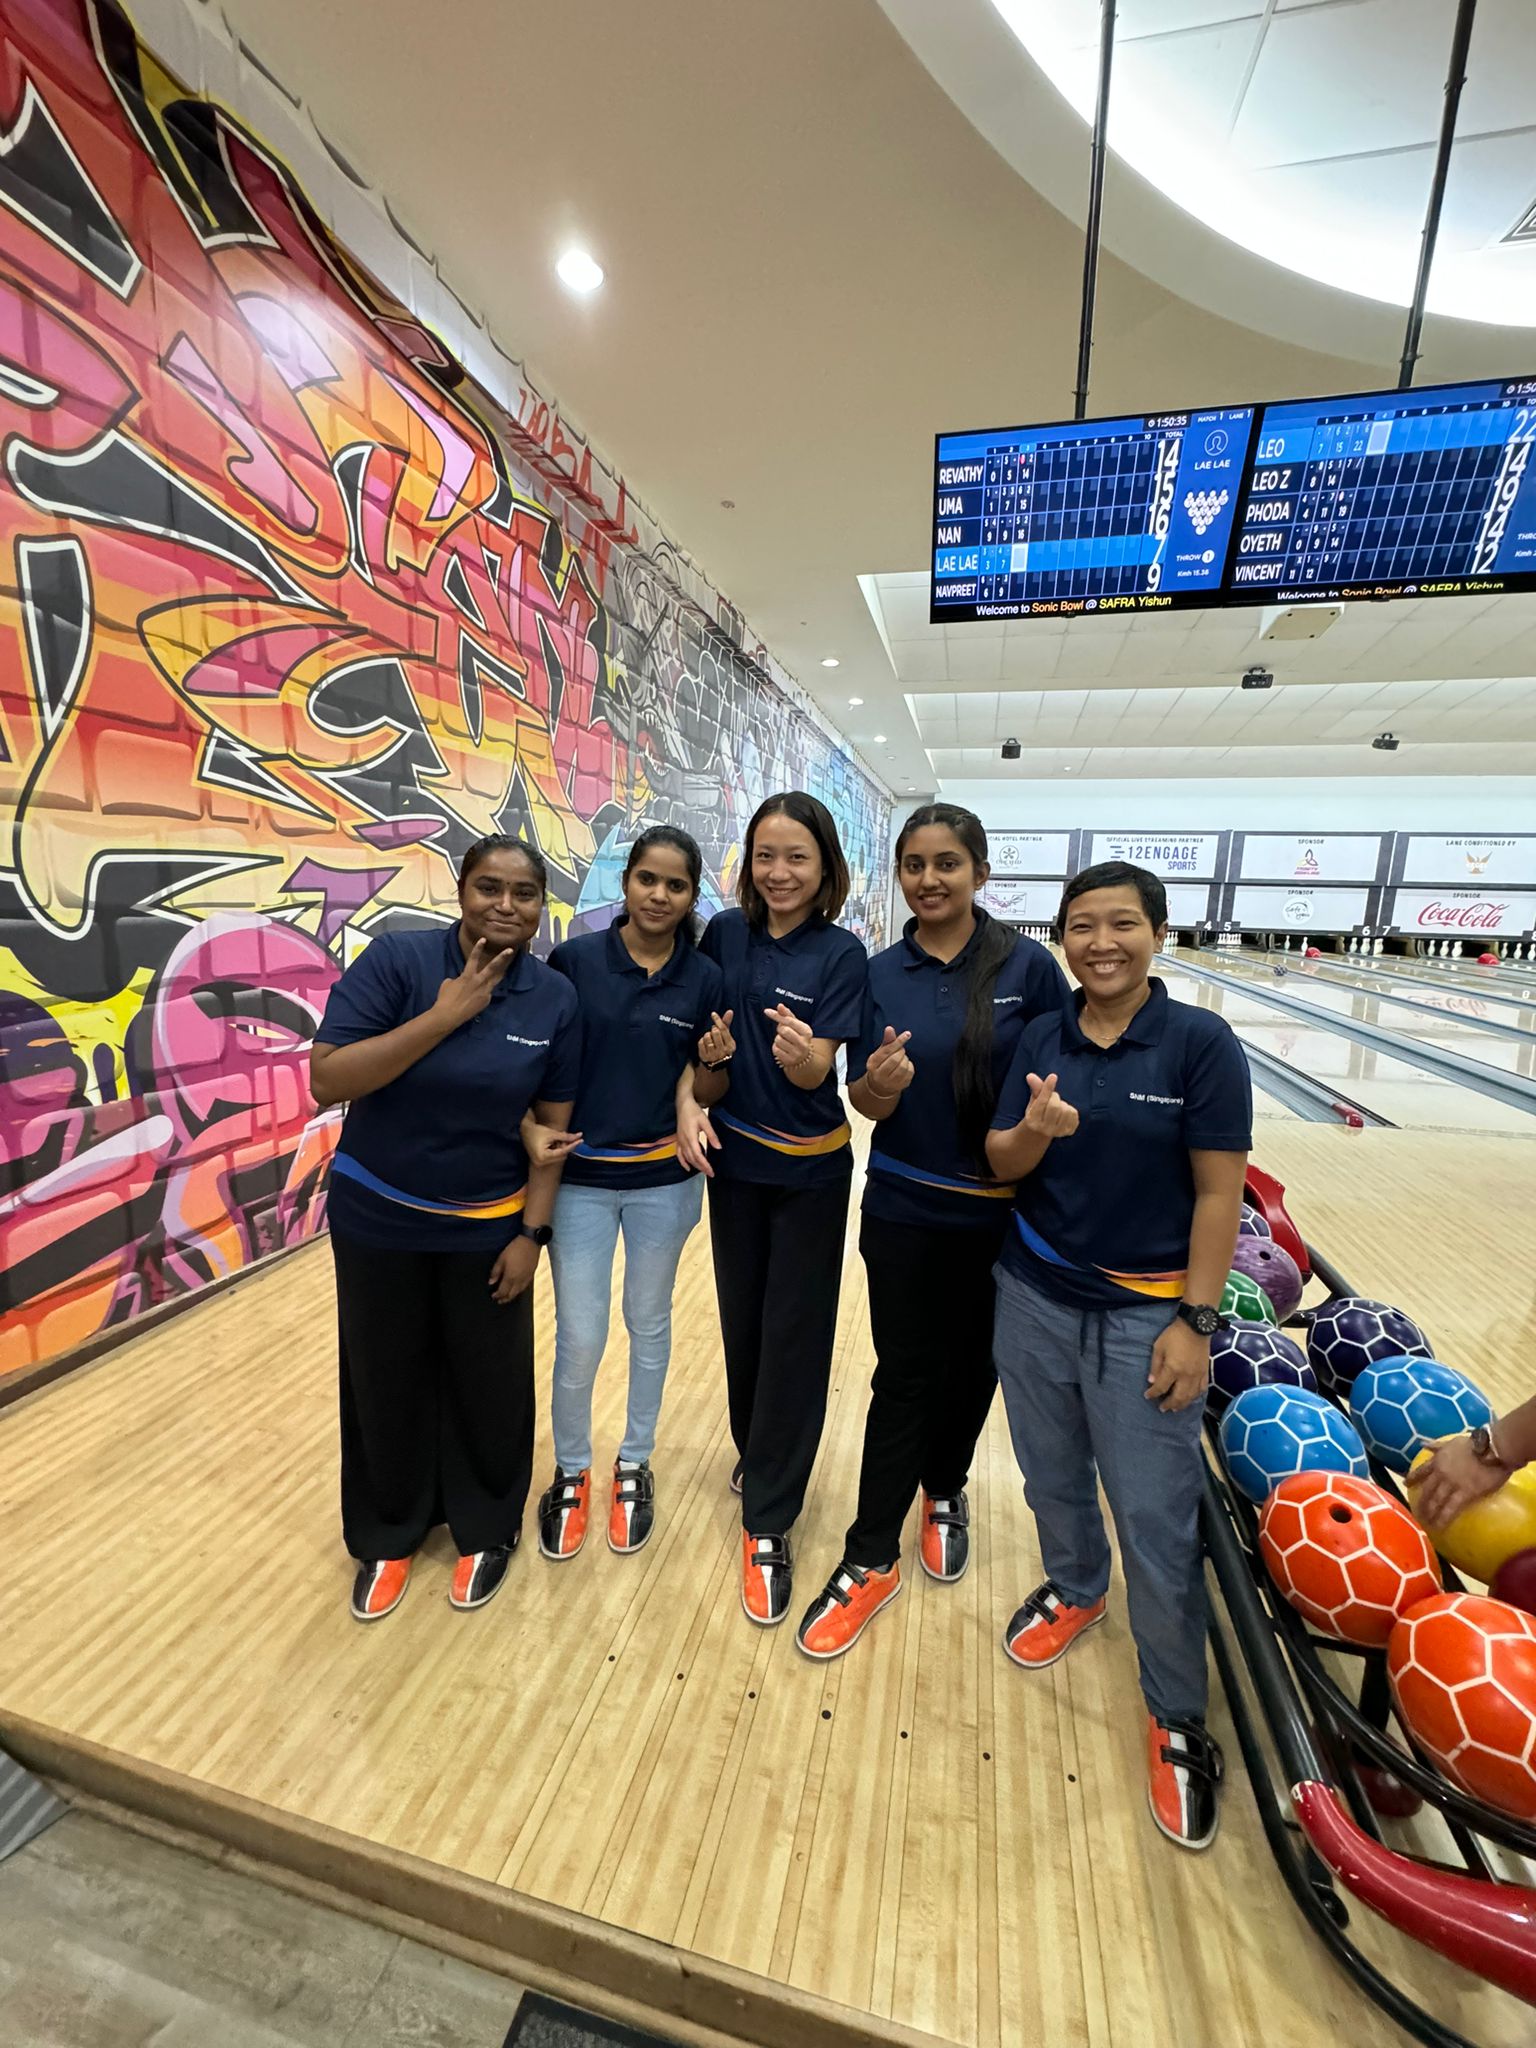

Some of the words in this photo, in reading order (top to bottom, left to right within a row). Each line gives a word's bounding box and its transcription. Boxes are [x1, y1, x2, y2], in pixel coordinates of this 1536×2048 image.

[1156, 416, 1187, 427] 1:50:35
[1229, 412, 1244, 420] LANE
[1258, 438, 1285, 459] LEO
[1353, 440, 1364, 451] 22
[939, 465, 984, 484] REVATHY
[1022, 468, 1030, 479] 14
[1158, 438, 1180, 476] 14
[1194, 462, 1211, 471] LAE
[1213, 459, 1231, 469] LAE
[1251, 470, 1279, 491] LEO
[1280, 469, 1291, 489] Z
[1501, 441, 1531, 479] 14
[938, 496, 963, 515] UMA
[1154, 471, 1176, 505] 15
[1245, 501, 1290, 523] PHODA
[1303, 509, 1309, 519] 4
[1490, 476, 1520, 512] 19
[937, 527, 961, 544] NAN
[1149, 503, 1171, 537] 16
[1240, 533, 1282, 553] OYETH
[1479, 510, 1508, 543] 14
[937, 556, 956, 572] LAE
[958, 554, 978, 570] LAE
[1155, 533, 1167, 565] 7
[1176, 554, 1202, 562] THROW
[1235, 564, 1283, 582] VINCENT
[1470, 542, 1498, 574] 12
[935, 584, 977, 598] NAVPREET
[1146, 562, 1161, 592] 9
[976, 605, 1019, 616] Welcome
[1020, 605, 1030, 613] to
[1031, 601, 1059, 613] Sonic
[1060, 600, 1084, 612] Bowl
[1085, 599, 1098, 610] @
[1099, 597, 1136, 609] SAFRA
[1139, 596, 1172, 607] Yishun
[1128, 846, 1198, 860] 12ENGAGE
[1168, 861, 1197, 871] SPORTS
[1204, 922, 1212, 931] 4
[1223, 922, 1232, 931] 5
[1362, 926, 1371, 936] 6
[1383, 926, 1391, 936] 7
[1130, 1092, 1146, 1101] SNM
[1146, 1094, 1184, 1106] (Singapore)
